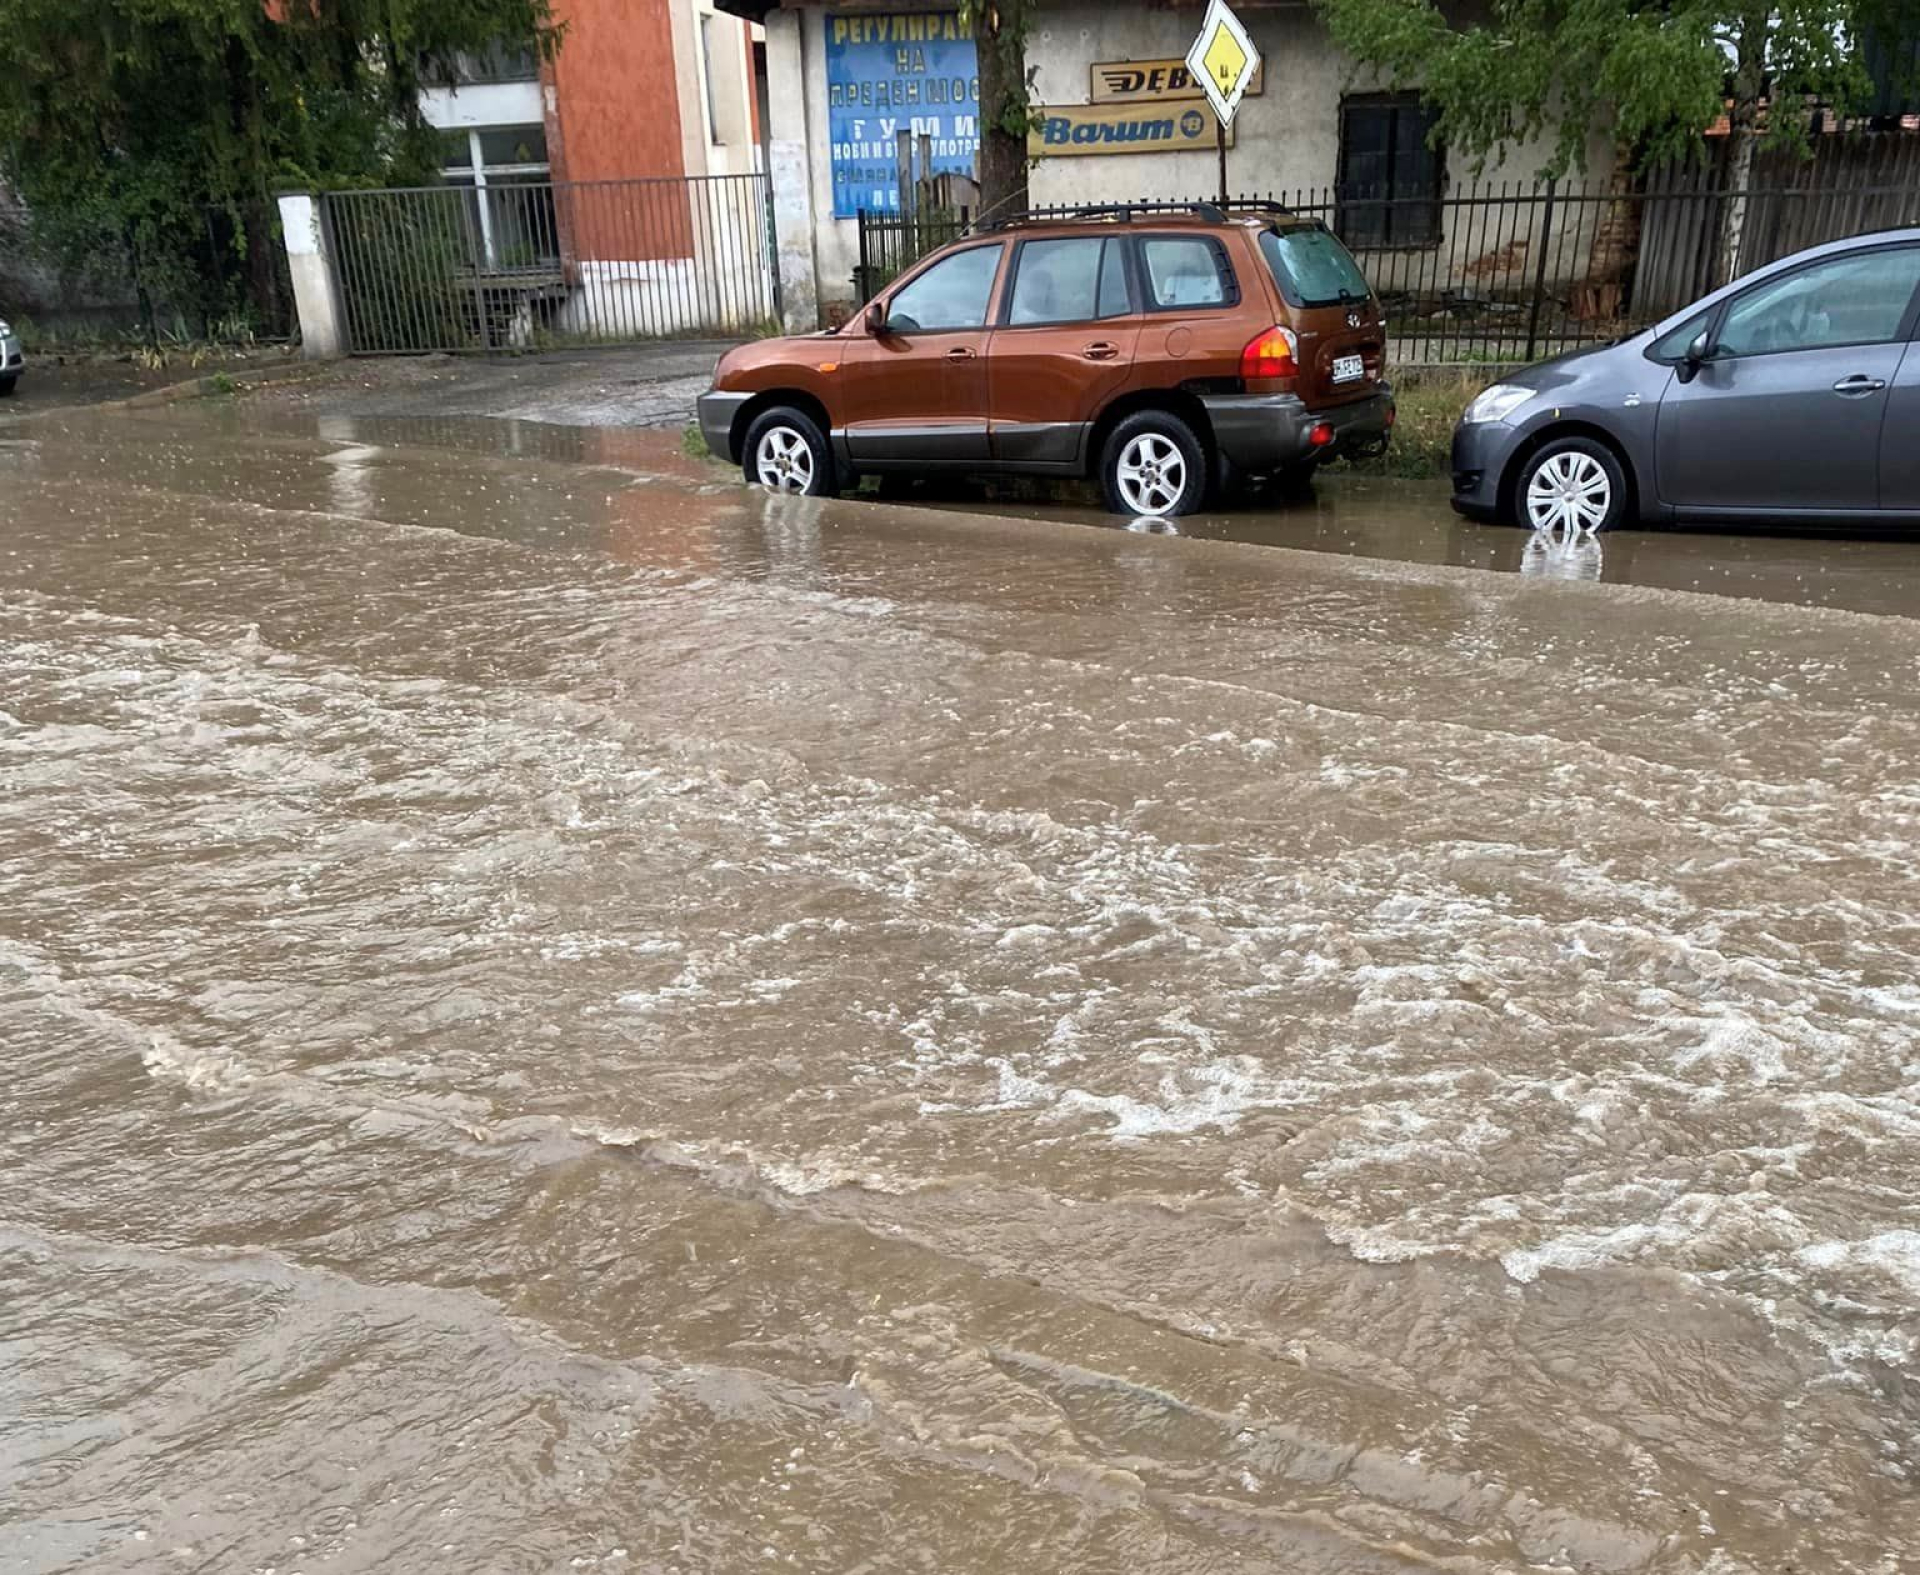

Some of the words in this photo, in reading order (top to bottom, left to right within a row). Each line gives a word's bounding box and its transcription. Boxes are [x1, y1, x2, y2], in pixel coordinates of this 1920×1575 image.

[834, 15, 973, 45] РЕГУЛИРАН
[895, 47, 926, 75] НА
[925, 76, 980, 105] МОС
[1101, 66, 1203, 94] DĘB
[853, 115, 975, 140] ГУМИ
[1043, 116, 1174, 145] Barum
[931, 138, 980, 157] УПОТРЕ
